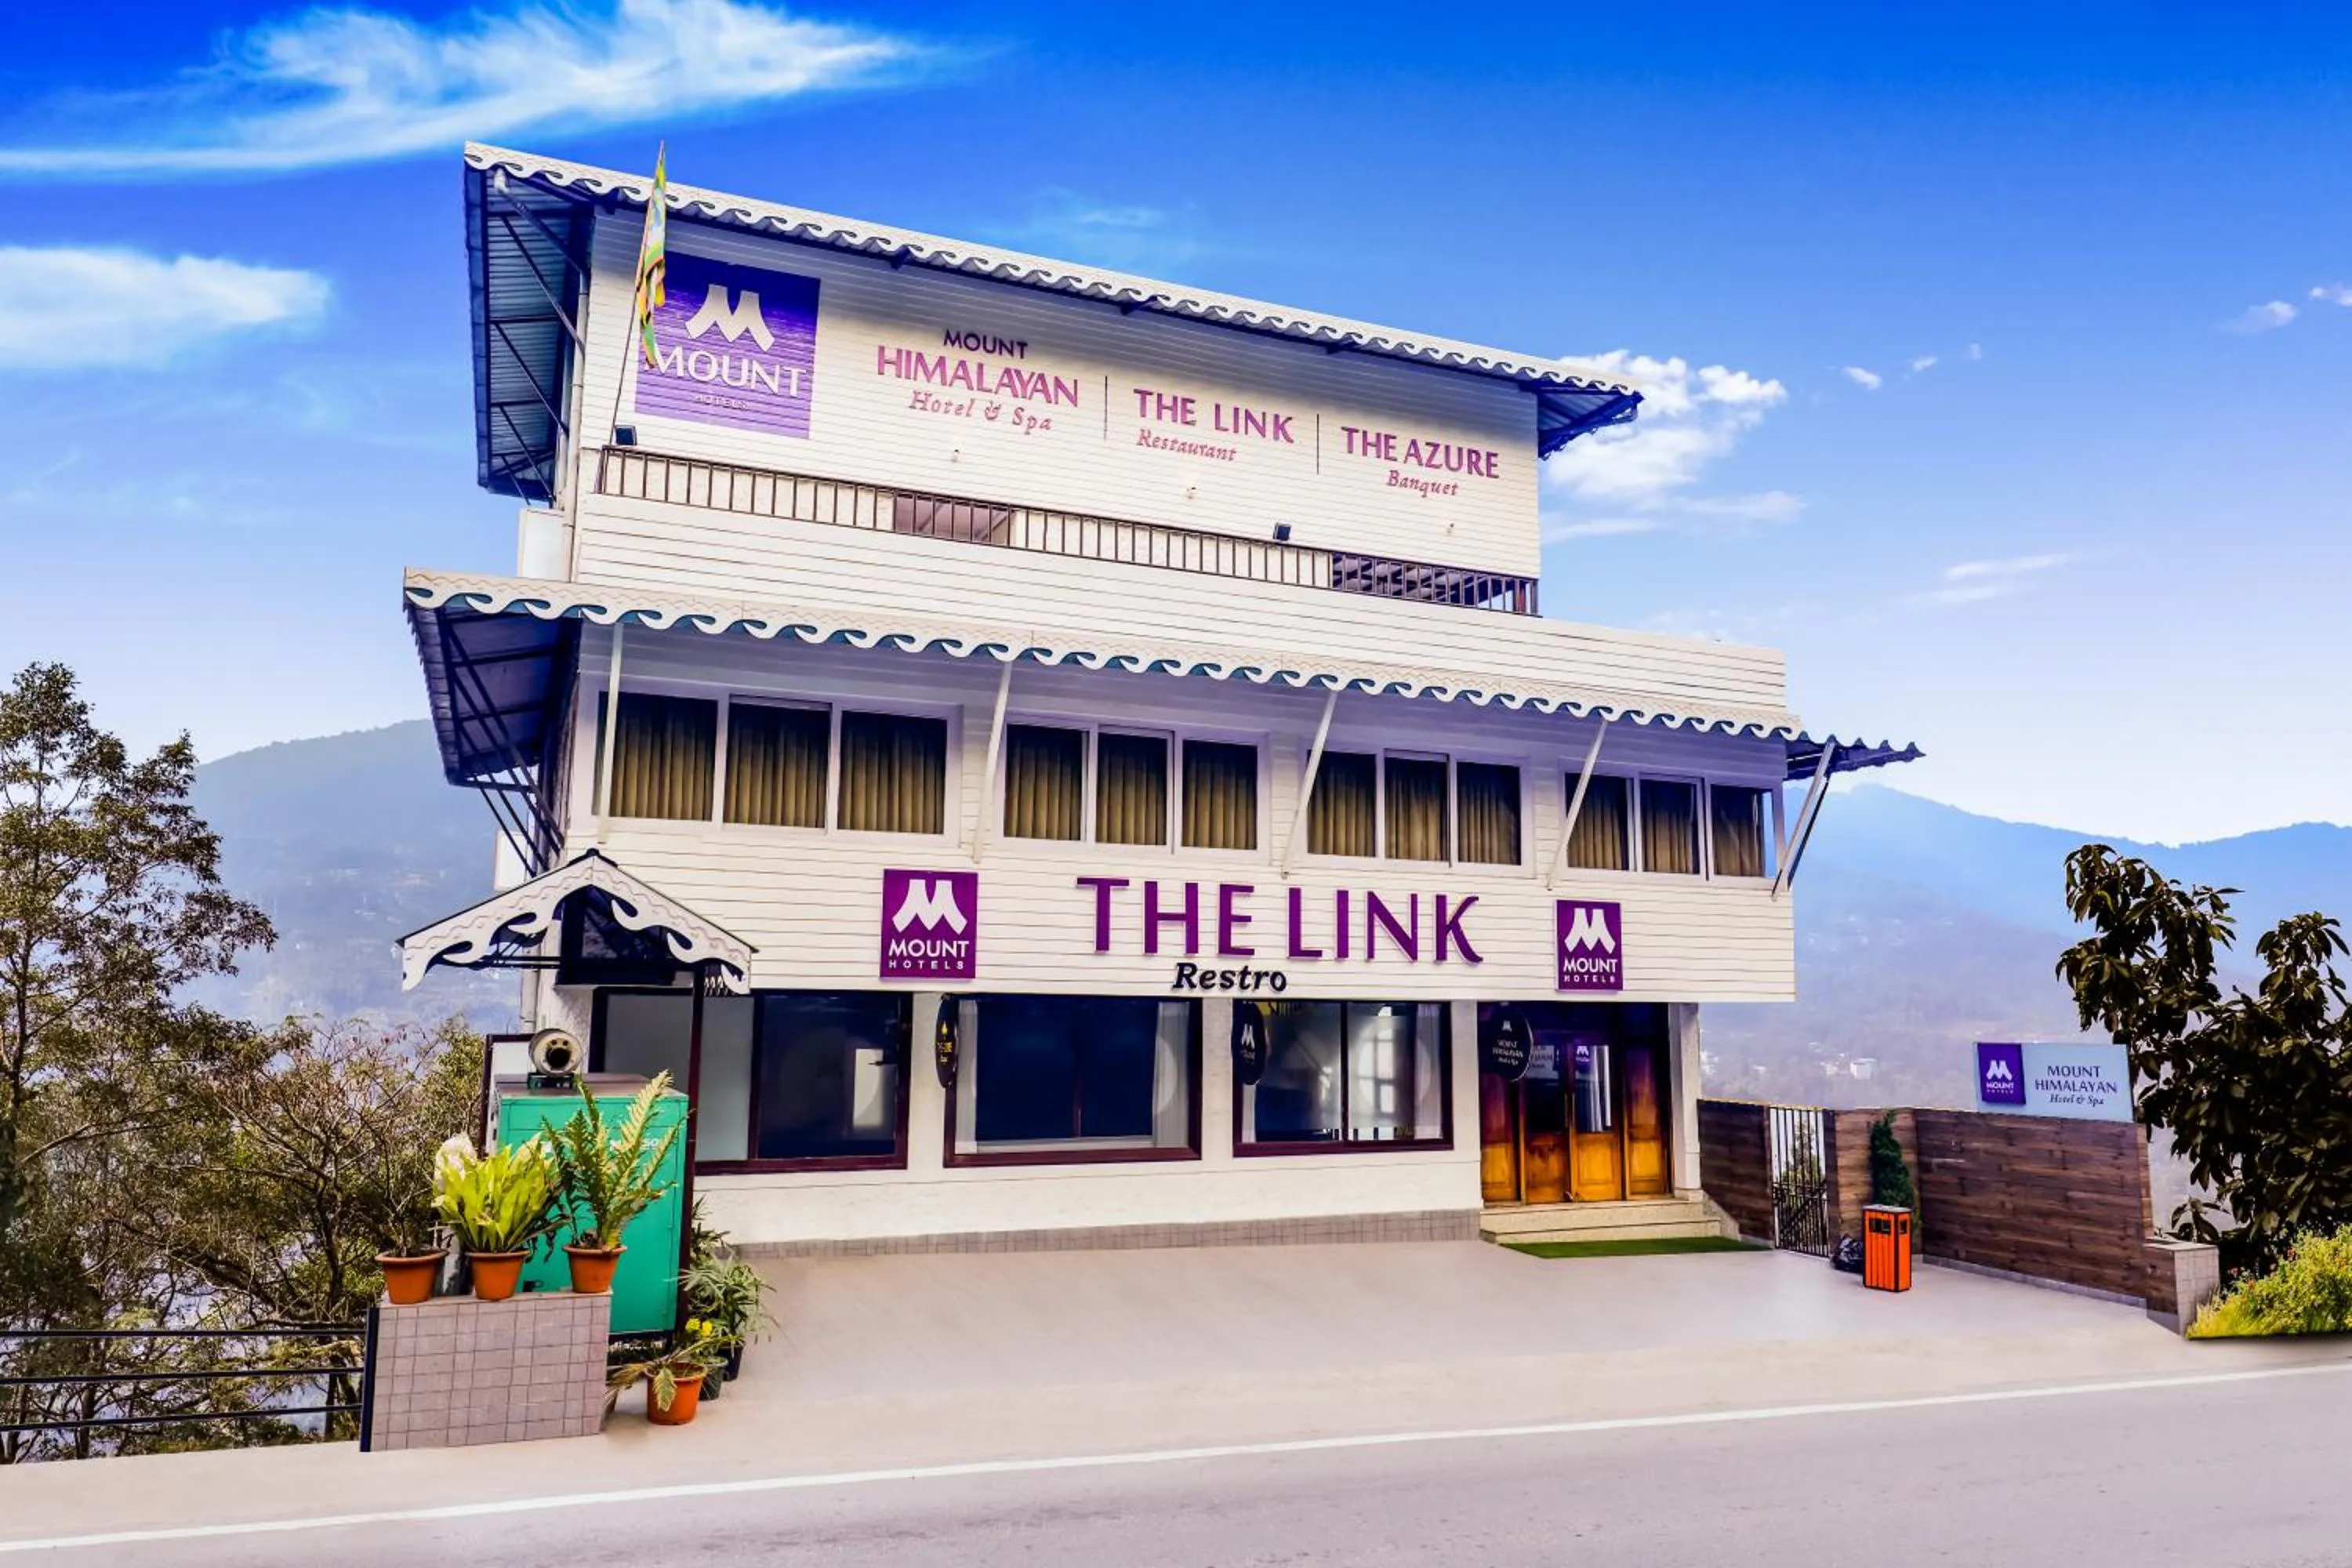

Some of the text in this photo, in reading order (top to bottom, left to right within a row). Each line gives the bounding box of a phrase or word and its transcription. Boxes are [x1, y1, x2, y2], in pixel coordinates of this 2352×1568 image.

[943, 329, 1028, 360] MOUNT
[643, 345, 808, 398] MOUNT
[877, 345, 1079, 408] HIMALAYAN
[908, 390, 1052, 435] Hotel & Spa
[1133, 388, 1294, 445] THE LINK
[1136, 427, 1237, 462] Restaurant
[1341, 426, 1500, 479] THE AZURE
[1386, 470, 1458, 498] Banquet
[1076, 877, 1484, 964] THE LINK
[888, 938, 970, 958] MOUNT
[888, 959, 964, 971] HOTELS
[1172, 961, 1288, 993] Restro
[1563, 956, 1618, 973] MOUNT
[1563, 975, 1616, 983] HOTELS
[2034, 1079, 2118, 1094] HIMALAYAN
[2047, 1065, 2101, 1078] MOUNT
[2087, 1094, 2105, 1108] Spa
